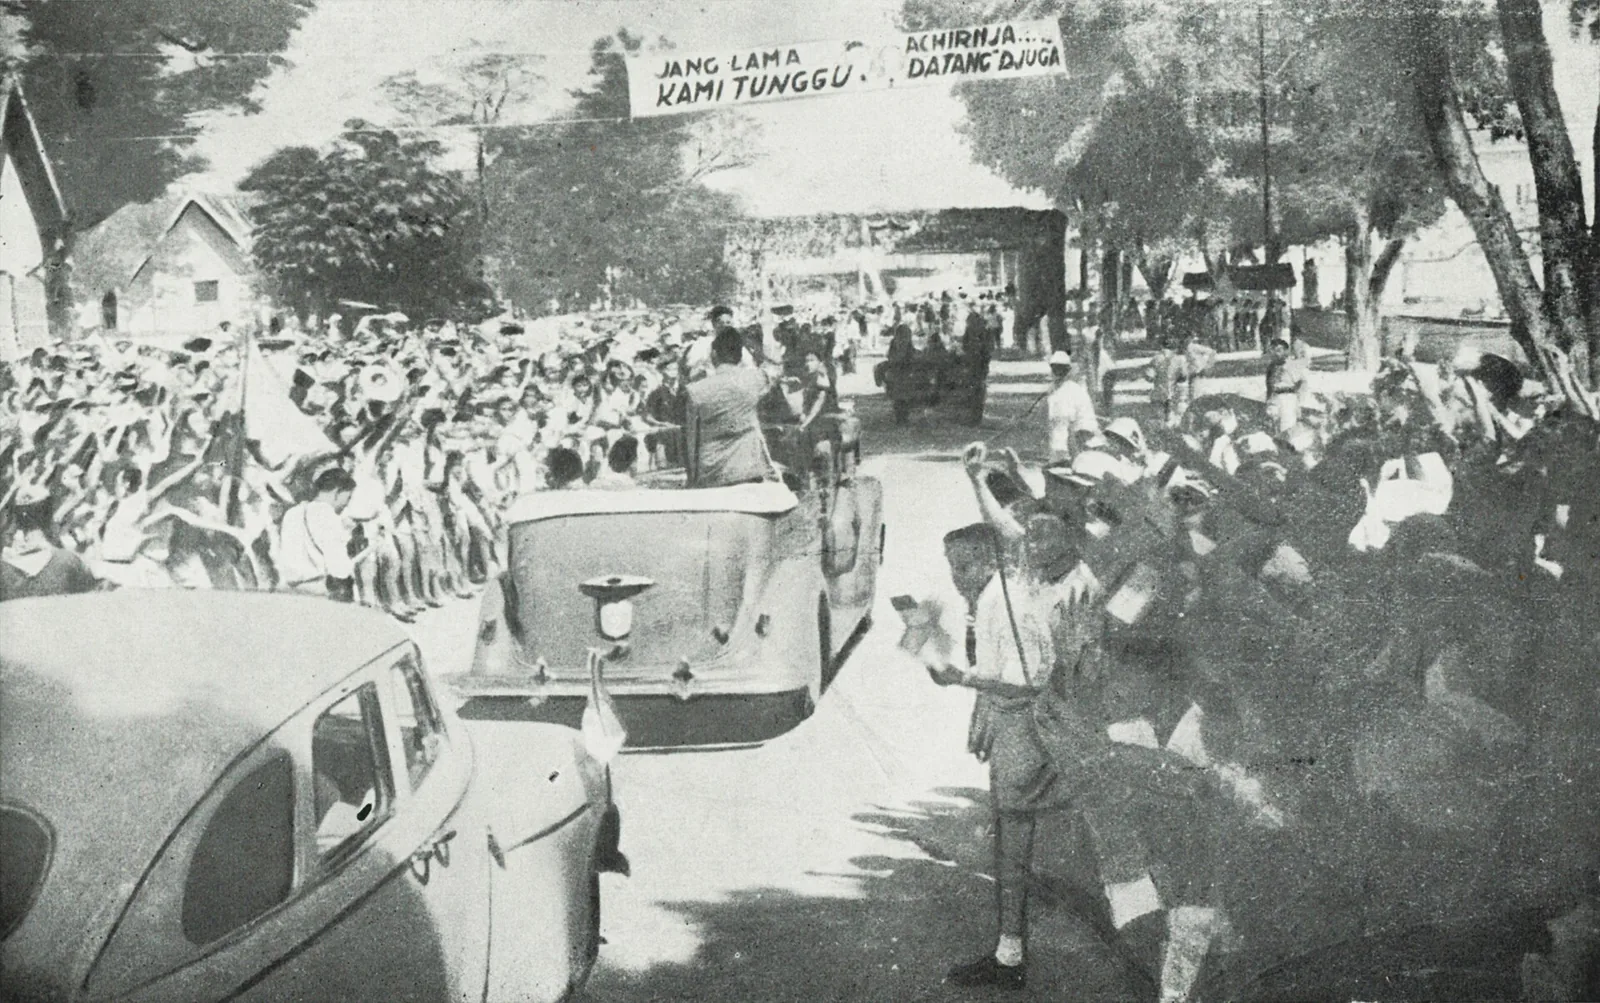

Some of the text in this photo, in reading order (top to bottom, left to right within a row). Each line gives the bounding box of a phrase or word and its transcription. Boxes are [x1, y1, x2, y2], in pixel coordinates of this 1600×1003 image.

[655, 49, 801, 79] JANG LAMA
[908, 46, 1060, 79] DATANG DJUGA
[656, 79, 724, 107] KAMI
